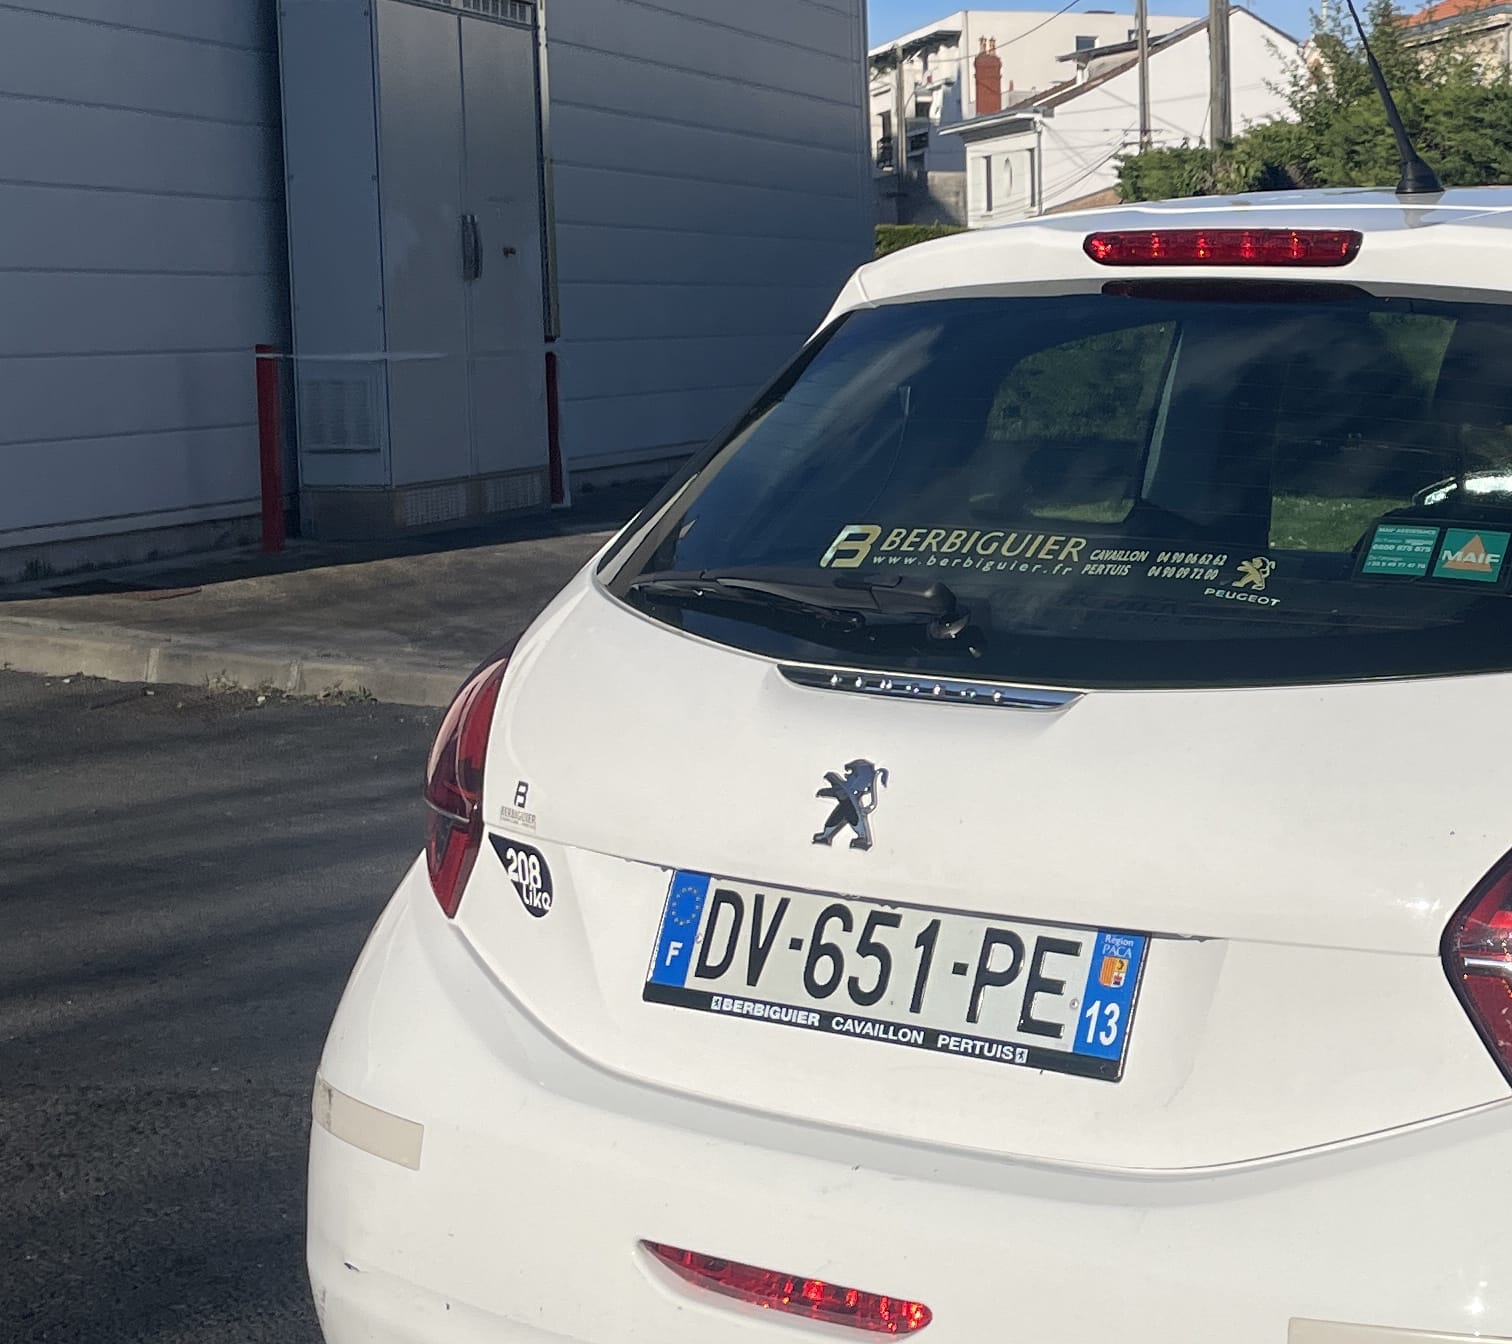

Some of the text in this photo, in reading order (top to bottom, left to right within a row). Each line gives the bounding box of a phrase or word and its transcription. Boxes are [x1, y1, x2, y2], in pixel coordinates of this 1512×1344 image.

[880, 528, 1086, 562] BERBIGUIER
[1090, 549, 1149, 563] CAVAILLON
[1156, 551, 1169, 563] 04
[1170, 552, 1184, 564] 90
[873, 554, 1073, 576] www.berbiguier.fr
[1442, 550, 1501, 565] MAIF
[1081, 564, 1132, 576] PERTUIS
[1147, 566, 1160, 577] 04
[1204, 587, 1281, 607] PEUGEOT
[506, 847, 542, 889] 208
[665, 942, 682, 966] F
[1102, 944, 1132, 959] PACA
[695, 888, 1082, 1039] DV-651-PE
[721, 998, 1015, 1061] BERBIGUIER CAVAILLON PERTUIS
[1085, 1000, 1121, 1046] 13
